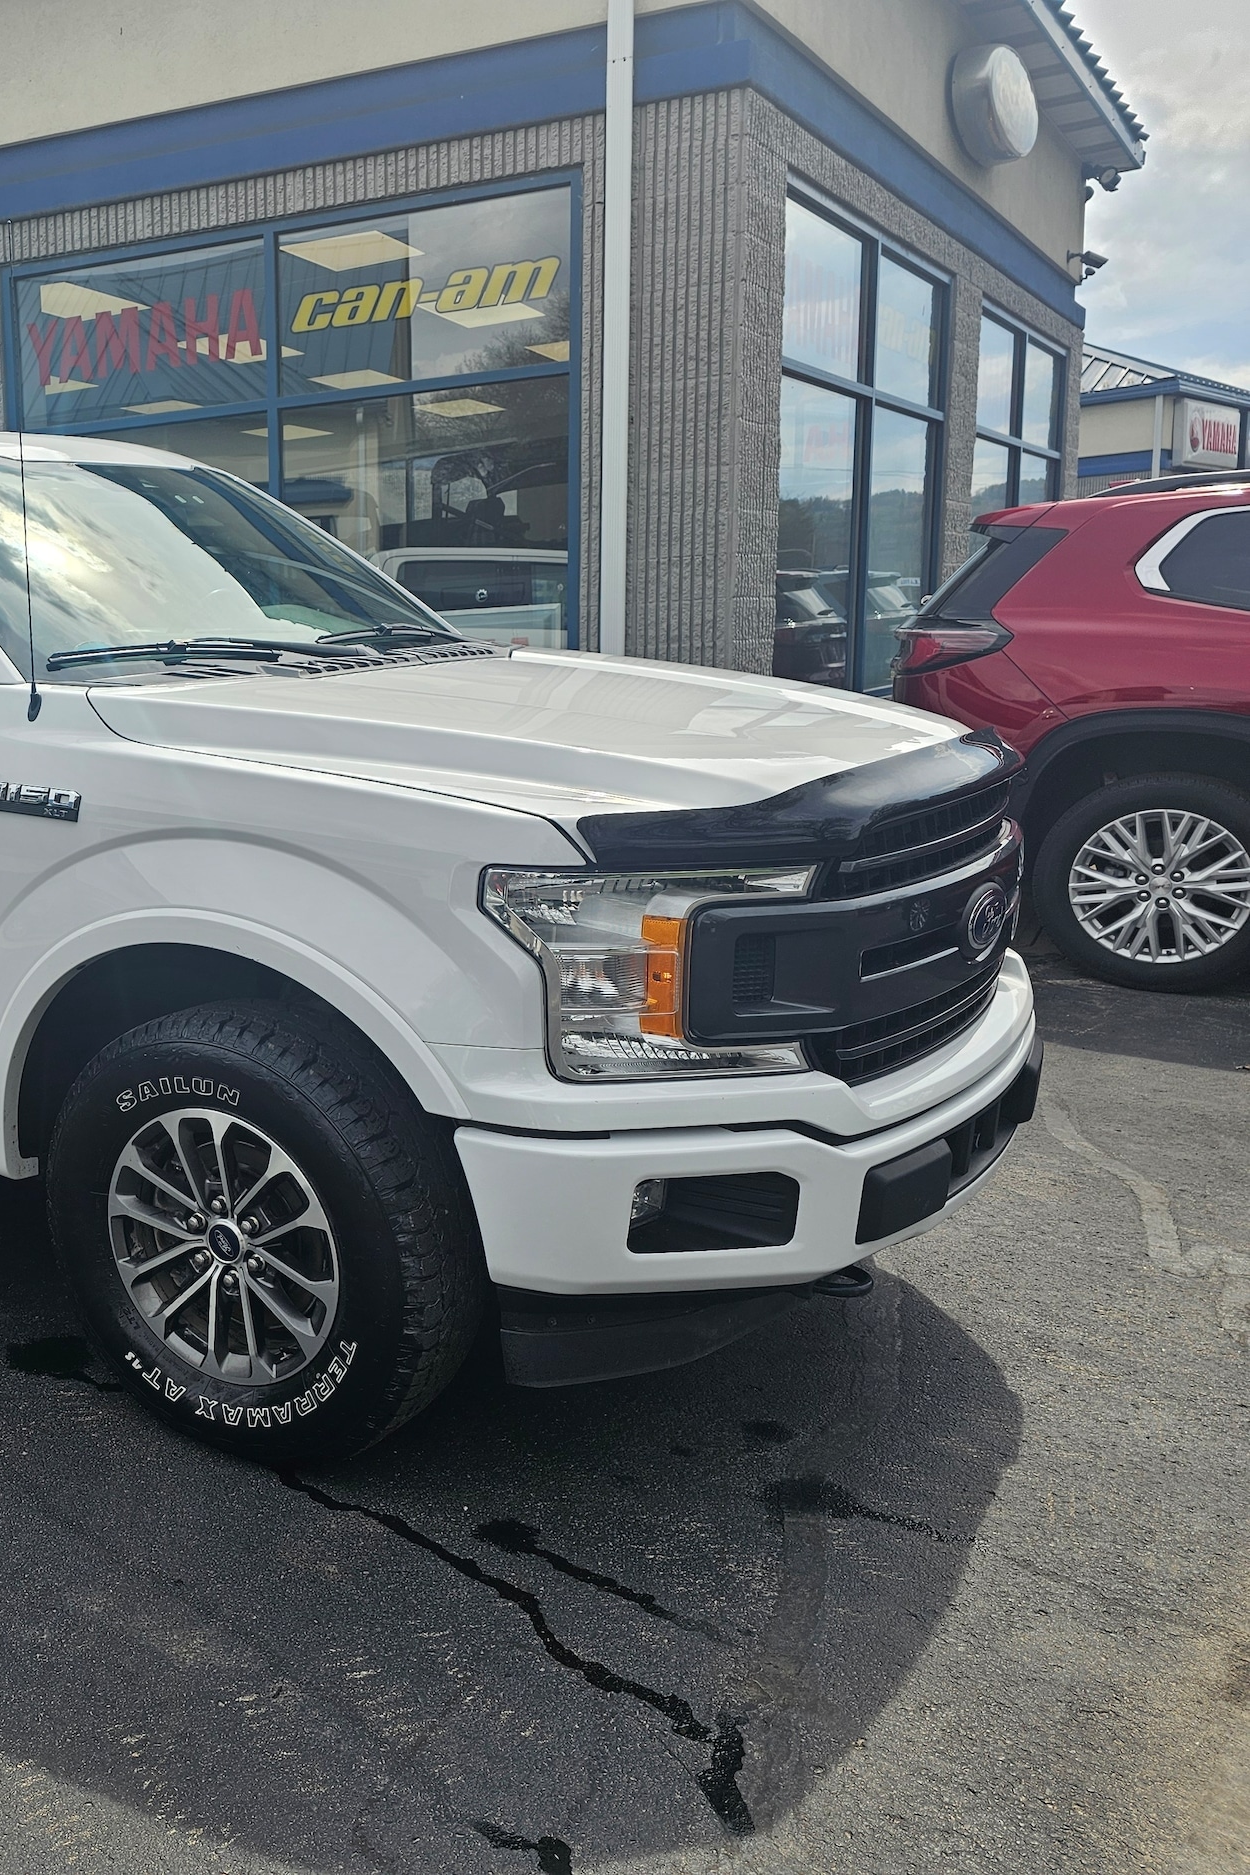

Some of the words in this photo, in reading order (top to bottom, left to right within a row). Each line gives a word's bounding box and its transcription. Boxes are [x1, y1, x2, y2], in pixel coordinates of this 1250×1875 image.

[291, 256, 561, 333] can-am
[27, 288, 262, 386] YAMAHA
[1202, 418, 1237, 455] YAMAHA
[116, 1076, 240, 1112] SAILUN
[195, 1340, 358, 1428] TERRAMAX
